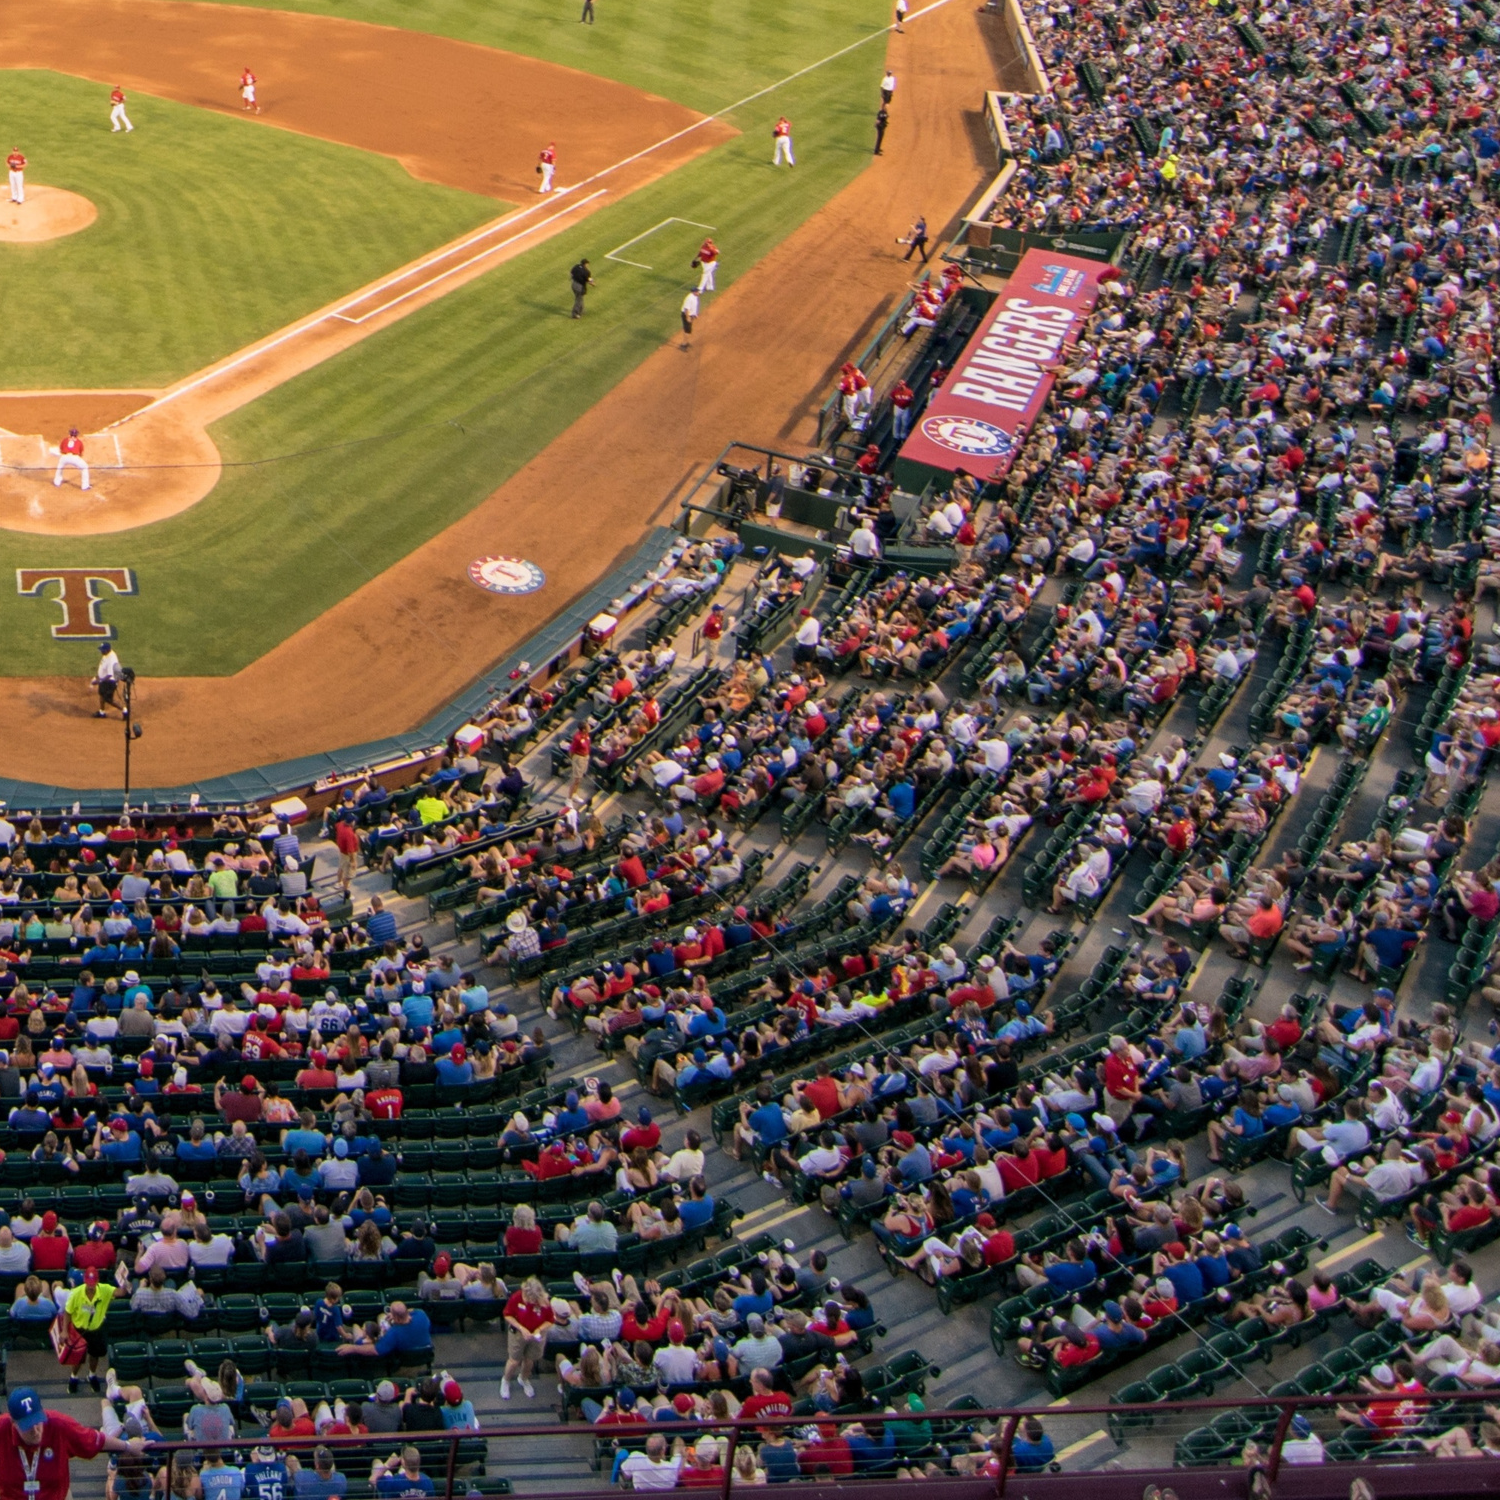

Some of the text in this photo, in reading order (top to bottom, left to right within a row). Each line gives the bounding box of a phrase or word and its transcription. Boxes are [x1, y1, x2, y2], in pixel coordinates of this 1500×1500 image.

[950, 297, 1076, 412] RANGERS
[16, 568, 139, 641] T
[244, 1043, 260, 1059] 29
[387, 1105, 393, 1119] 1
[21, 1397, 33, 1413] T
[755, 1403, 789, 1420] HAMILTON
[258, 1483, 283, 1500] 56
